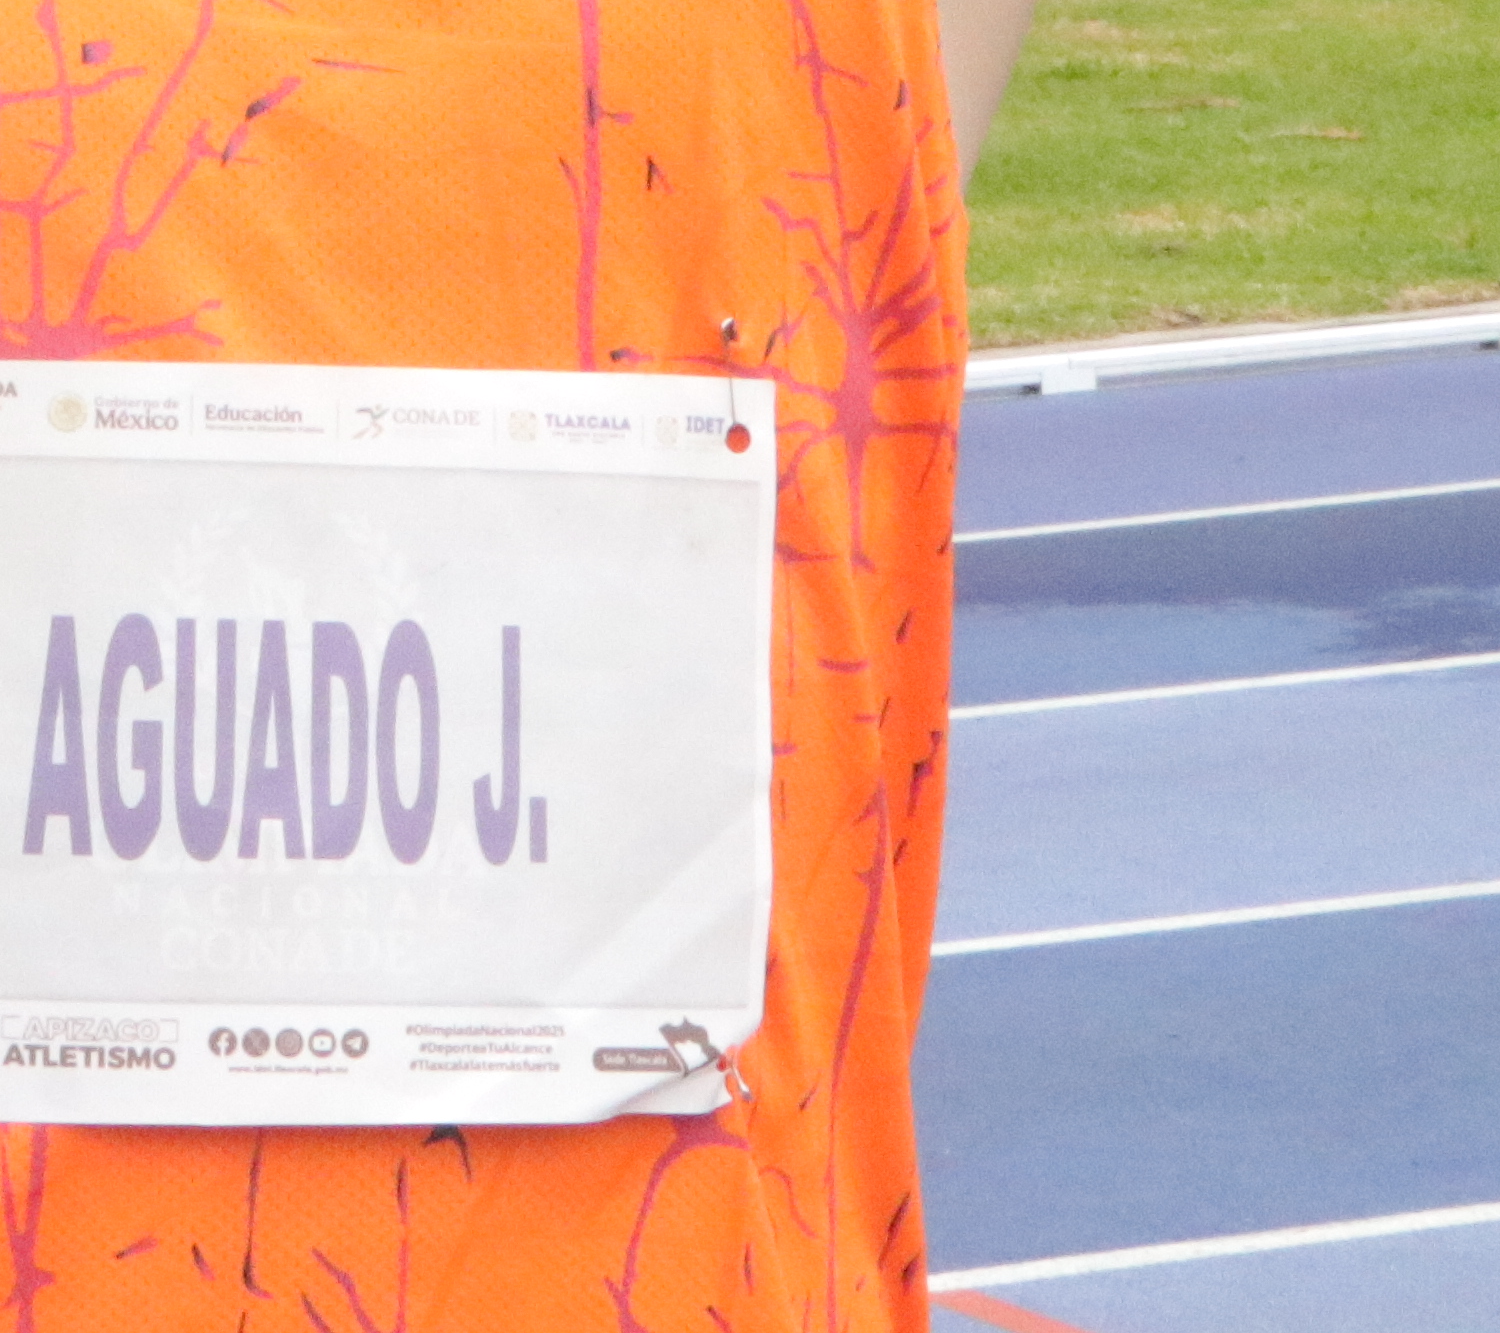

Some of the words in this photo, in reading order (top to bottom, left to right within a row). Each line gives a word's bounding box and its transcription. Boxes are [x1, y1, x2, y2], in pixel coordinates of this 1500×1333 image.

[94, 397, 160, 410] Gobierno
[162, 398, 179, 409] de
[205, 403, 303, 423] Educación
[94, 408, 179, 431] México
[392, 408, 480, 427] CONADE
[545, 413, 631, 431] TLAXCALA
[686, 415, 725, 435] IDET
[22, 612, 440, 866] AGUADO
[473, 625, 548, 867] J.
[23, 1016, 160, 1043] APIZACO
[2, 1043, 177, 1071] ATLETISMO
